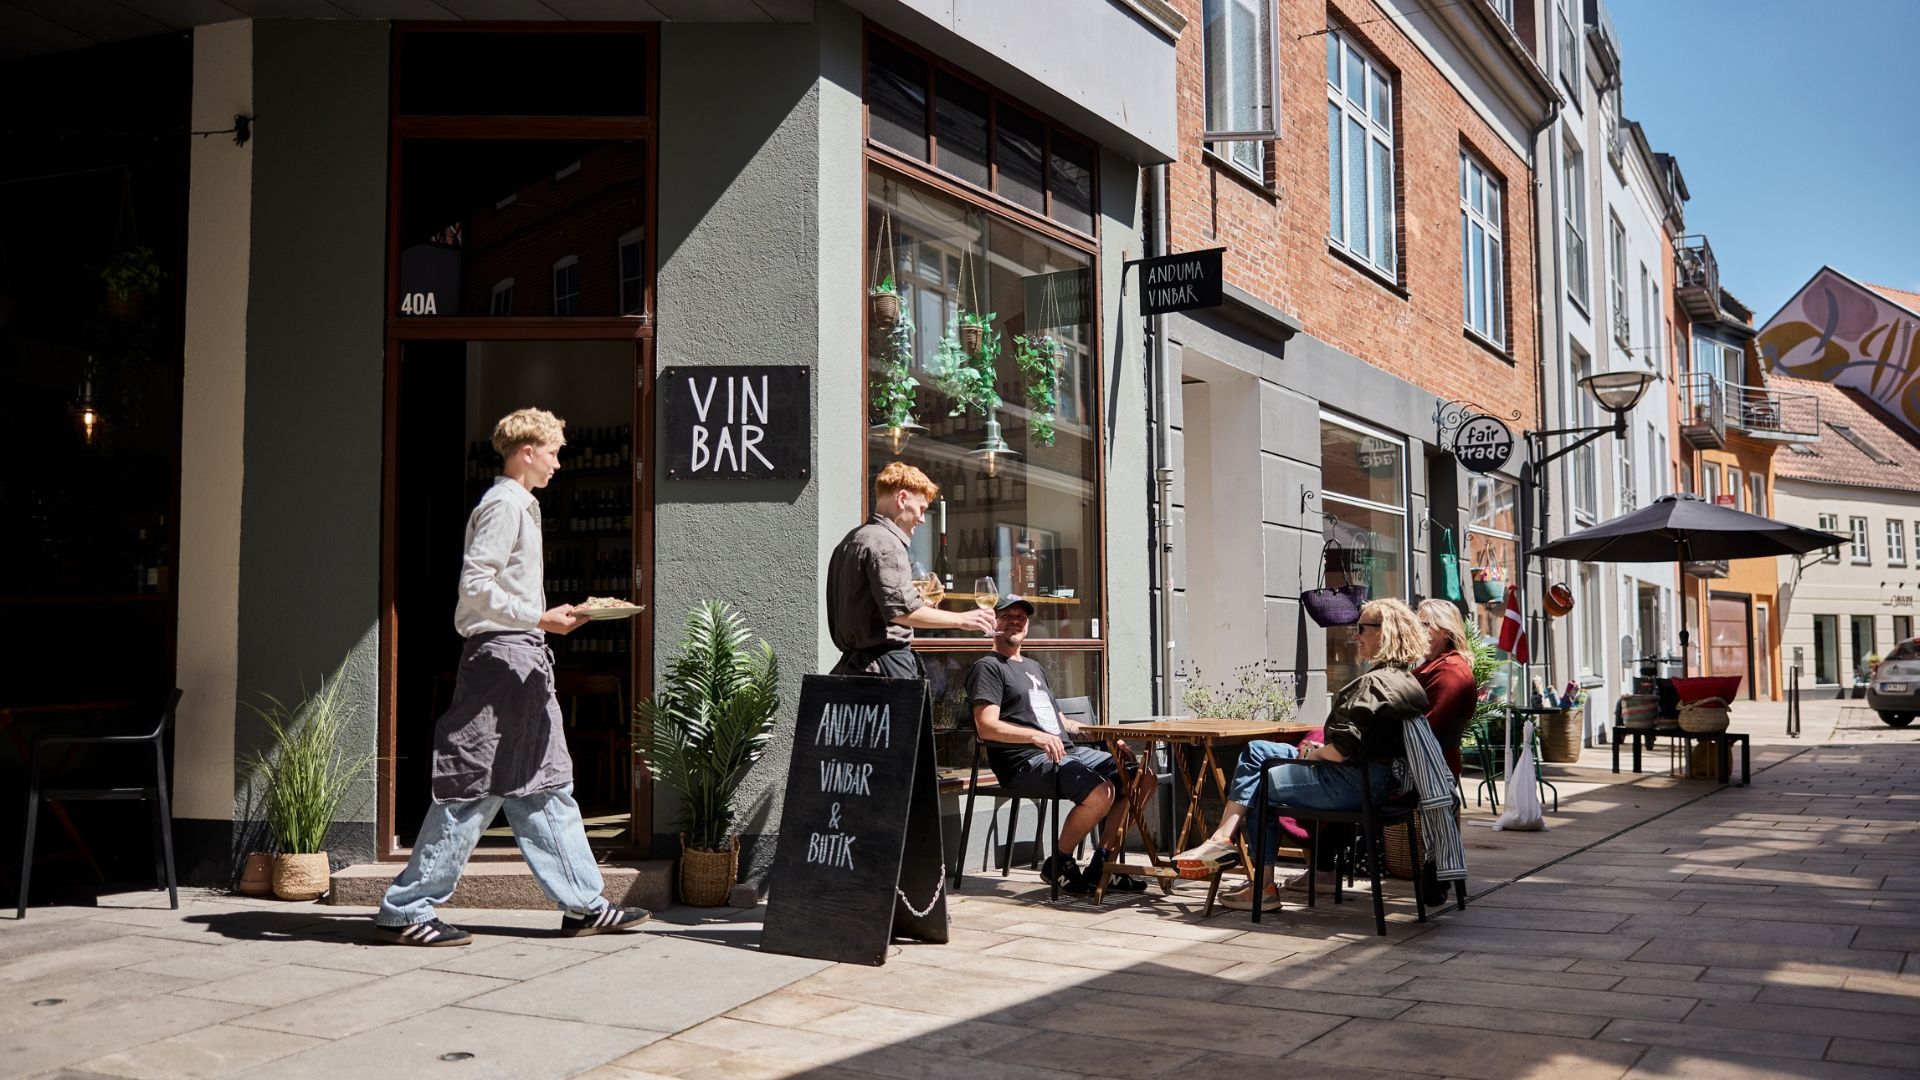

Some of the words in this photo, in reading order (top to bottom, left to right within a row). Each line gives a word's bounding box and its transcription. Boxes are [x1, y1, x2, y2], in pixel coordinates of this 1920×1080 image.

[1148, 260, 1204, 284] ANDUMA
[401, 292, 437, 315] 40A
[1148, 284, 1199, 307] VINBAR
[688, 375, 768, 424] VIN
[1467, 425, 1499, 444] fair
[691, 425, 775, 472] BAR
[1458, 443, 1508, 460] trade
[815, 703, 890, 748] ANDUMA
[828, 802, 842, 830] &
